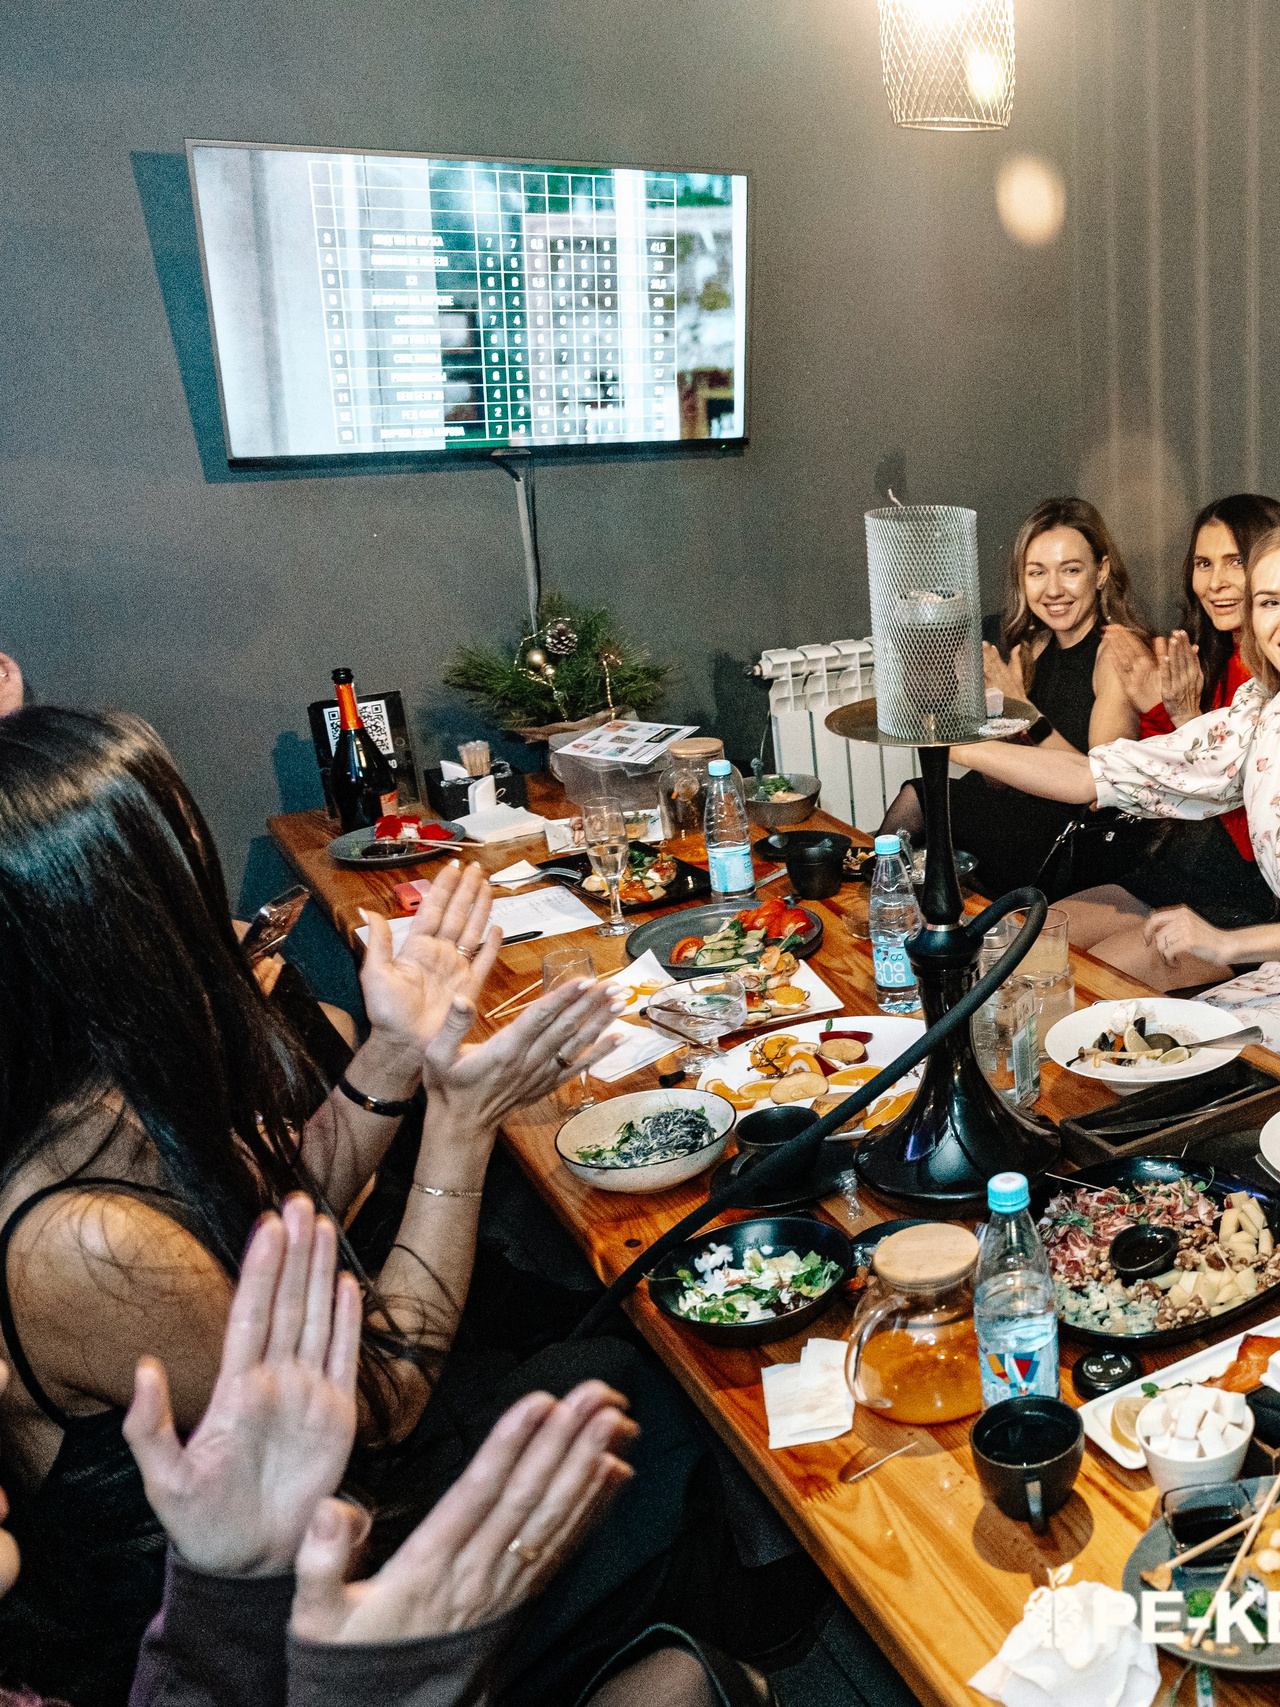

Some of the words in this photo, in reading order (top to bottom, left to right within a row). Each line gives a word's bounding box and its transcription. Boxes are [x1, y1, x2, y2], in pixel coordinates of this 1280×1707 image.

[485, 237, 492, 247] 7
[510, 238, 517, 248] 7
[580, 240, 587, 250] 7
[513, 296, 520, 306] 4
[536, 296, 543, 306] 7
[332, 315, 339, 325] 7
[490, 315, 497, 325] 7
[514, 315, 520, 325] 4
[605, 315, 612, 325] 4
[515, 352, 522, 362] 4
[538, 352, 545, 362] 7
[561, 351, 568, 361] 7
[606, 351, 613, 361] 4
[338, 393, 348, 402] 11
[494, 389, 500, 399] 4
[606, 386, 613, 396] 4
[495, 407, 502, 417] 2
[518, 406, 525, 416] 4
[563, 405, 570, 415] 4
[495, 425, 502, 435] 7
[518, 424, 526, 434] 3
[541, 423, 548, 433] 2
[586, 422, 592, 432] 4
[874, 960, 905, 973] ona
[875, 971, 906, 985] qua
